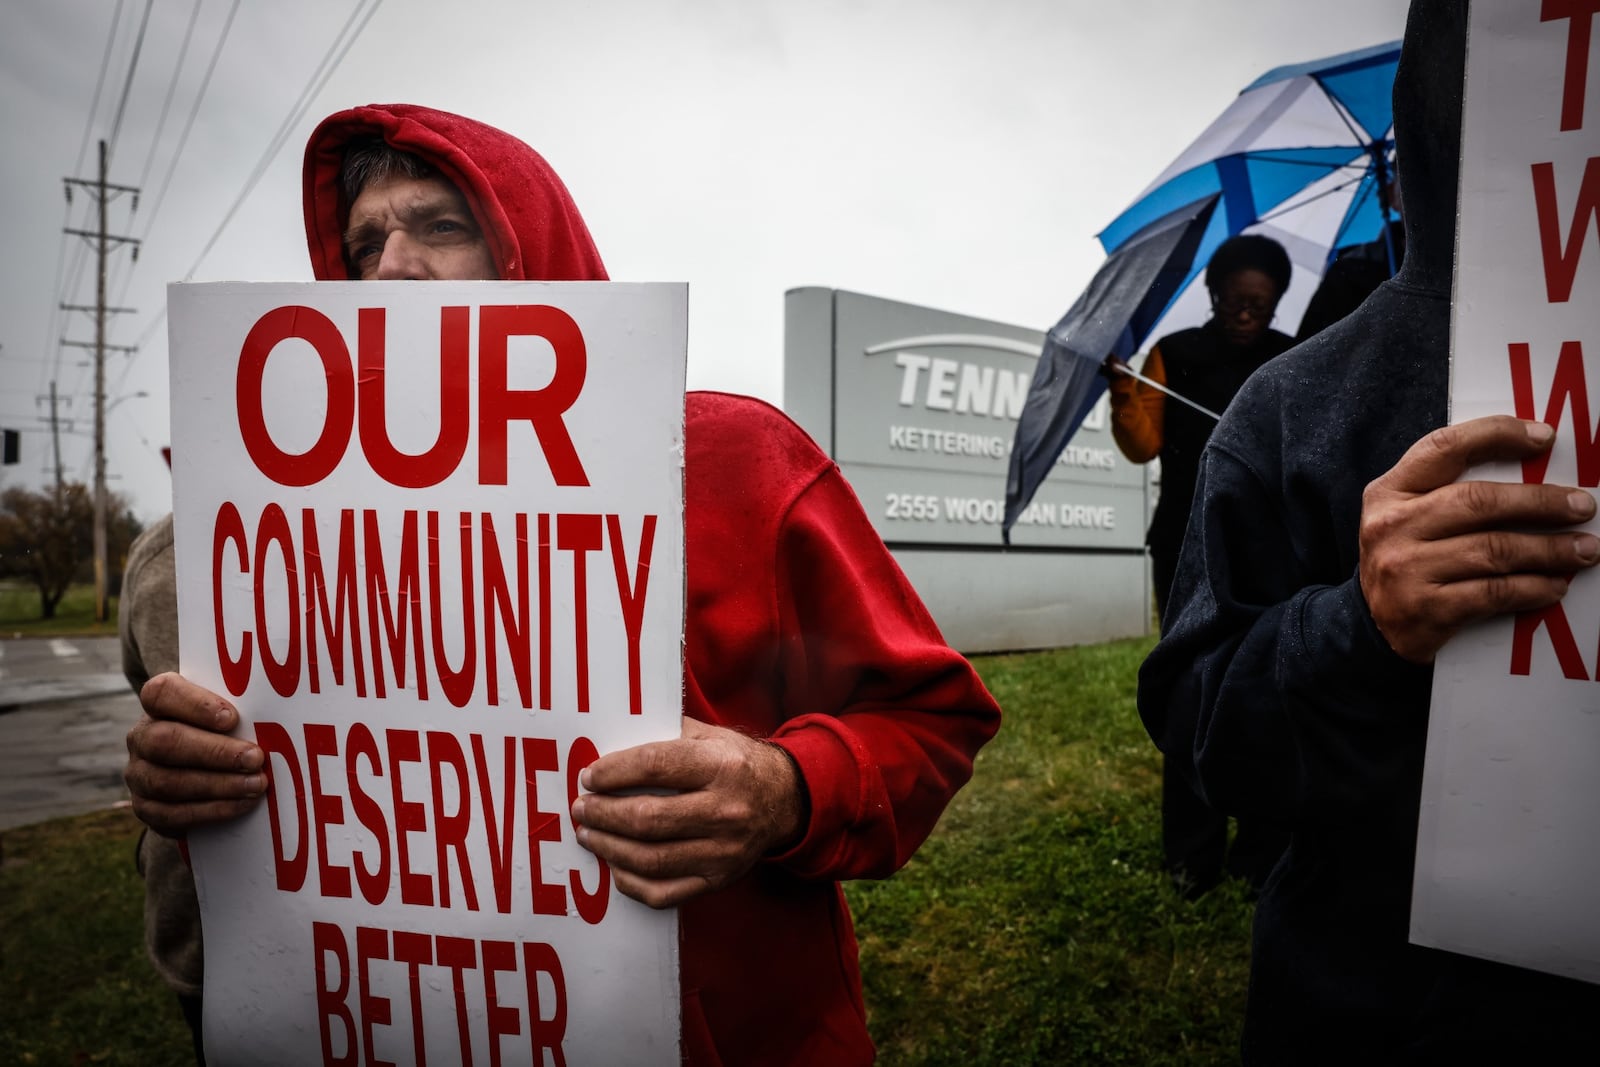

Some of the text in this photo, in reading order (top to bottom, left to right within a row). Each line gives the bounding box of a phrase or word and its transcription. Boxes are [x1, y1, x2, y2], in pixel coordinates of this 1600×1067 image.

[236, 304, 591, 488] OUR
[889, 425, 1116, 469] KETTERING ATIONS
[885, 492, 1115, 530] 2555 WOOAN DRIVE
[212, 502, 658, 716] COMMUNITY
[254, 722, 611, 925] DESERVES
[312, 921, 568, 1067] BETTER
